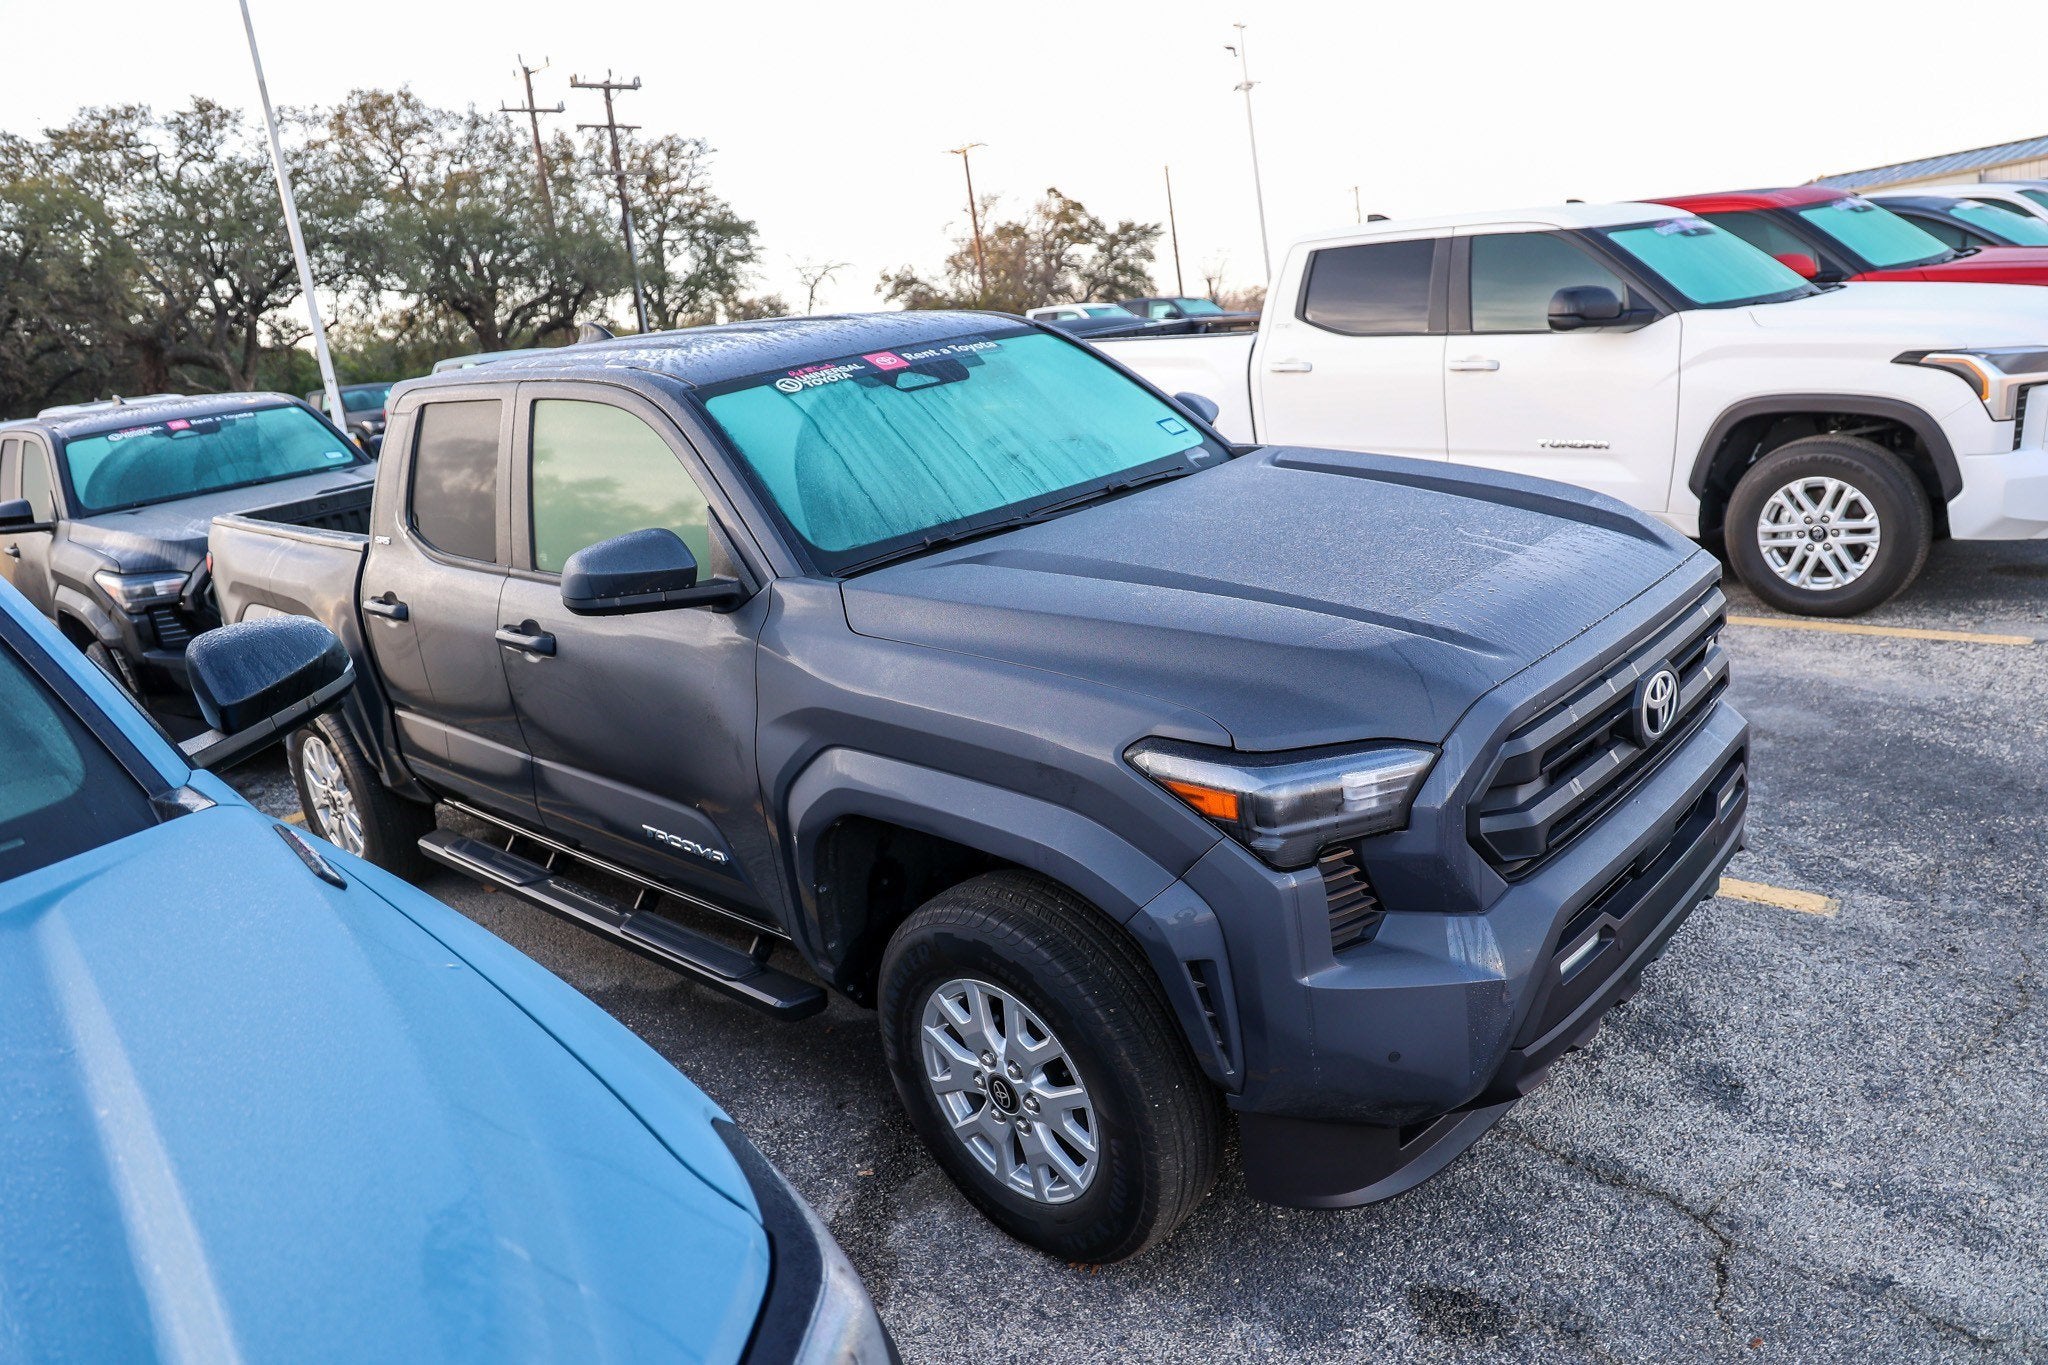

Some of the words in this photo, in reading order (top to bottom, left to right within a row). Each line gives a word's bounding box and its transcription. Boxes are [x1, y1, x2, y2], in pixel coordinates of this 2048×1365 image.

[901, 349, 940, 361] Rent
[947, 341, 998, 352] Toyota
[795, 363, 865, 382] UNIVERSAL
[802, 371, 854, 388] TOYOTA
[641, 824, 729, 866] TACOMA
